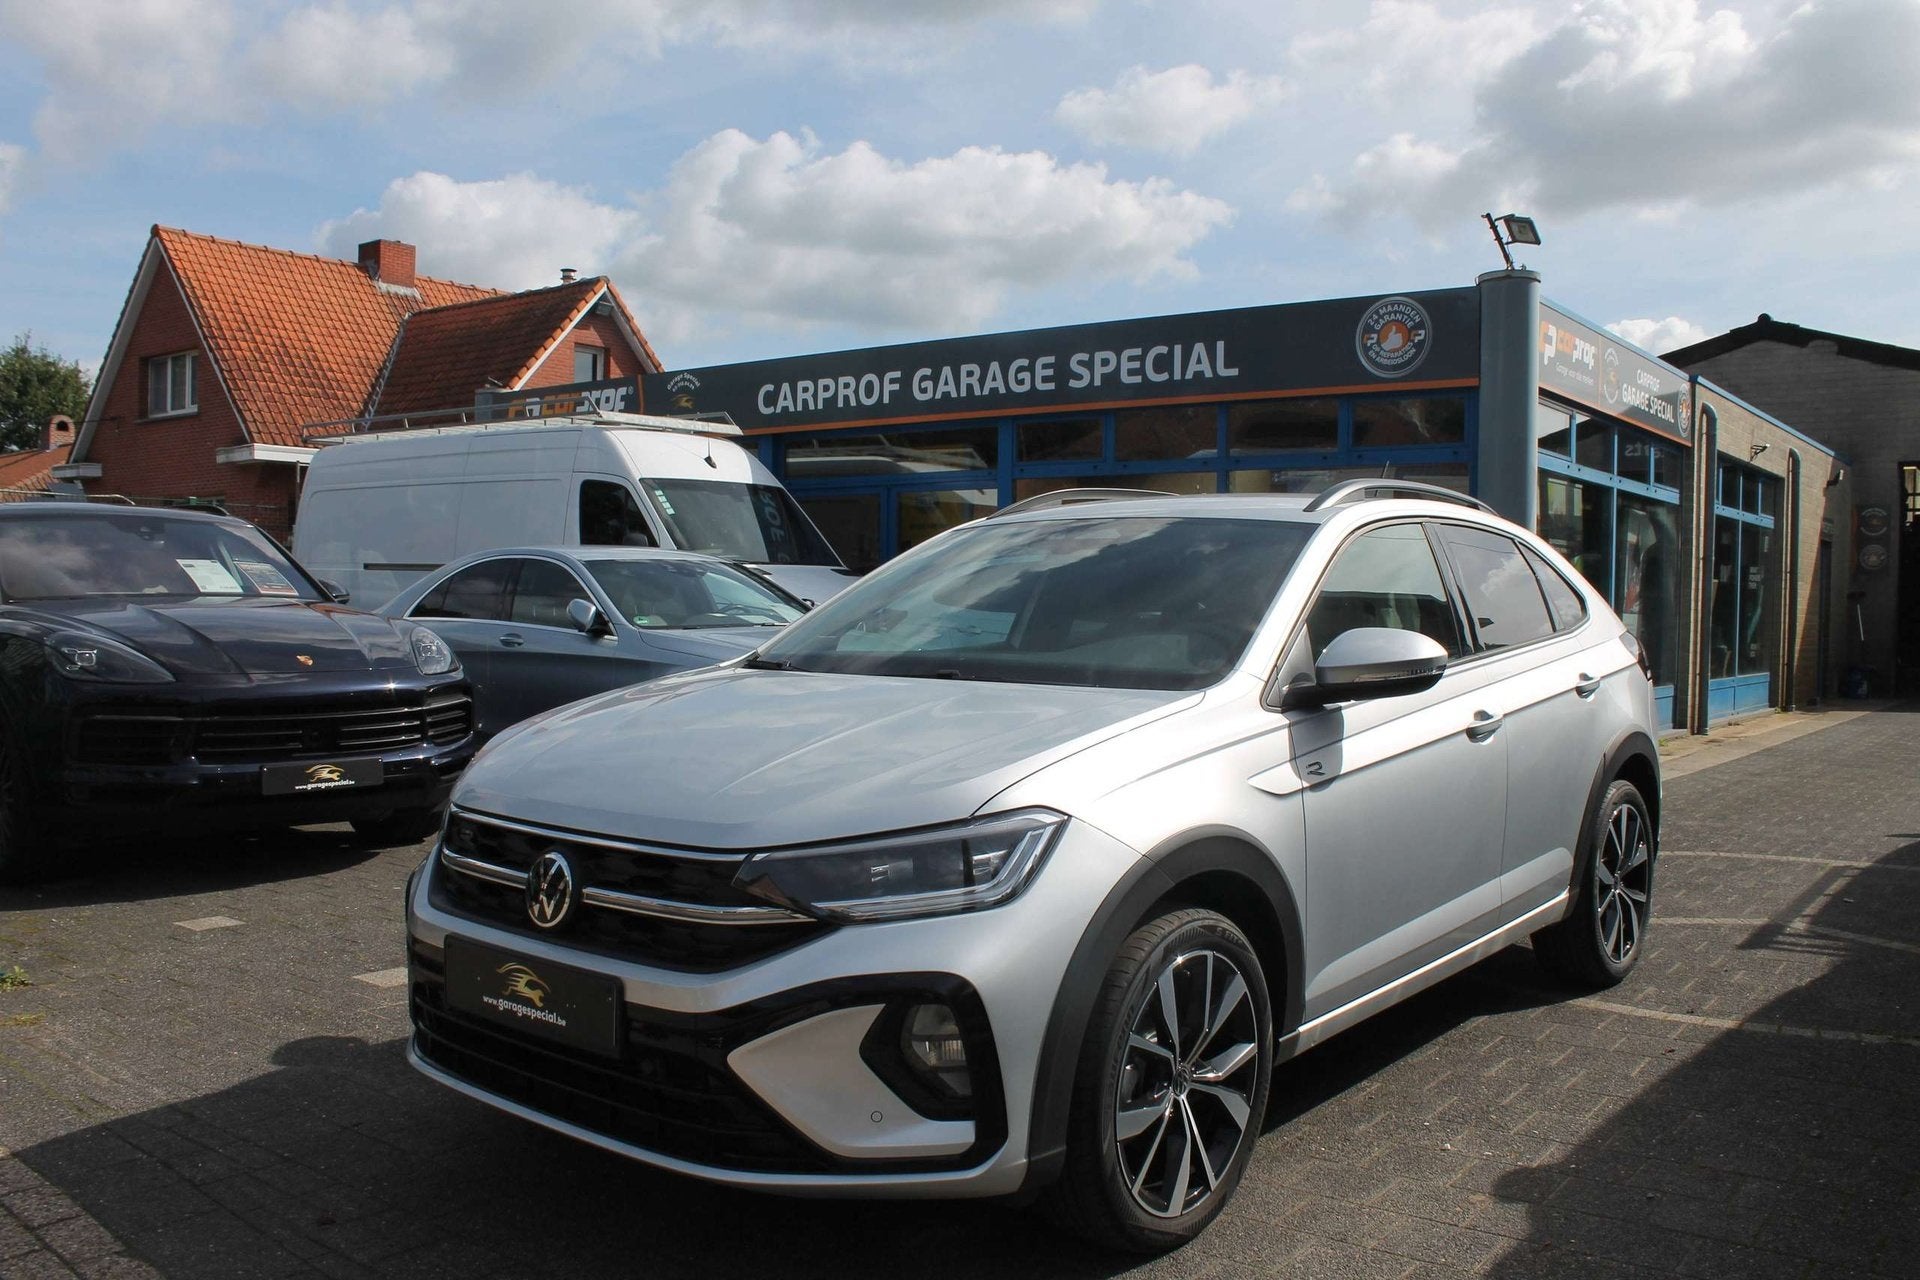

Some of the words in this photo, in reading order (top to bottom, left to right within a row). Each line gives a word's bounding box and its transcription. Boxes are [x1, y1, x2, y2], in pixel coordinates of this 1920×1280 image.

[1368, 314, 1378, 326] 24
[1379, 304, 1421, 323] MAANDEN
[1374, 313, 1415, 330] GARANTIE
[758, 370, 902, 415] CARPROF
[912, 356, 1056, 402] GARAGE
[1068, 340, 1239, 388] SPECIAL
[1636, 369, 1660, 392] CARPROF
[1622, 383, 1649, 412] GARAGE
[1649, 395, 1675, 423] SPECIAL
[295, 778, 355, 790] www.garagespecial.be
[482, 994, 567, 1027] www.garagespecial.be
